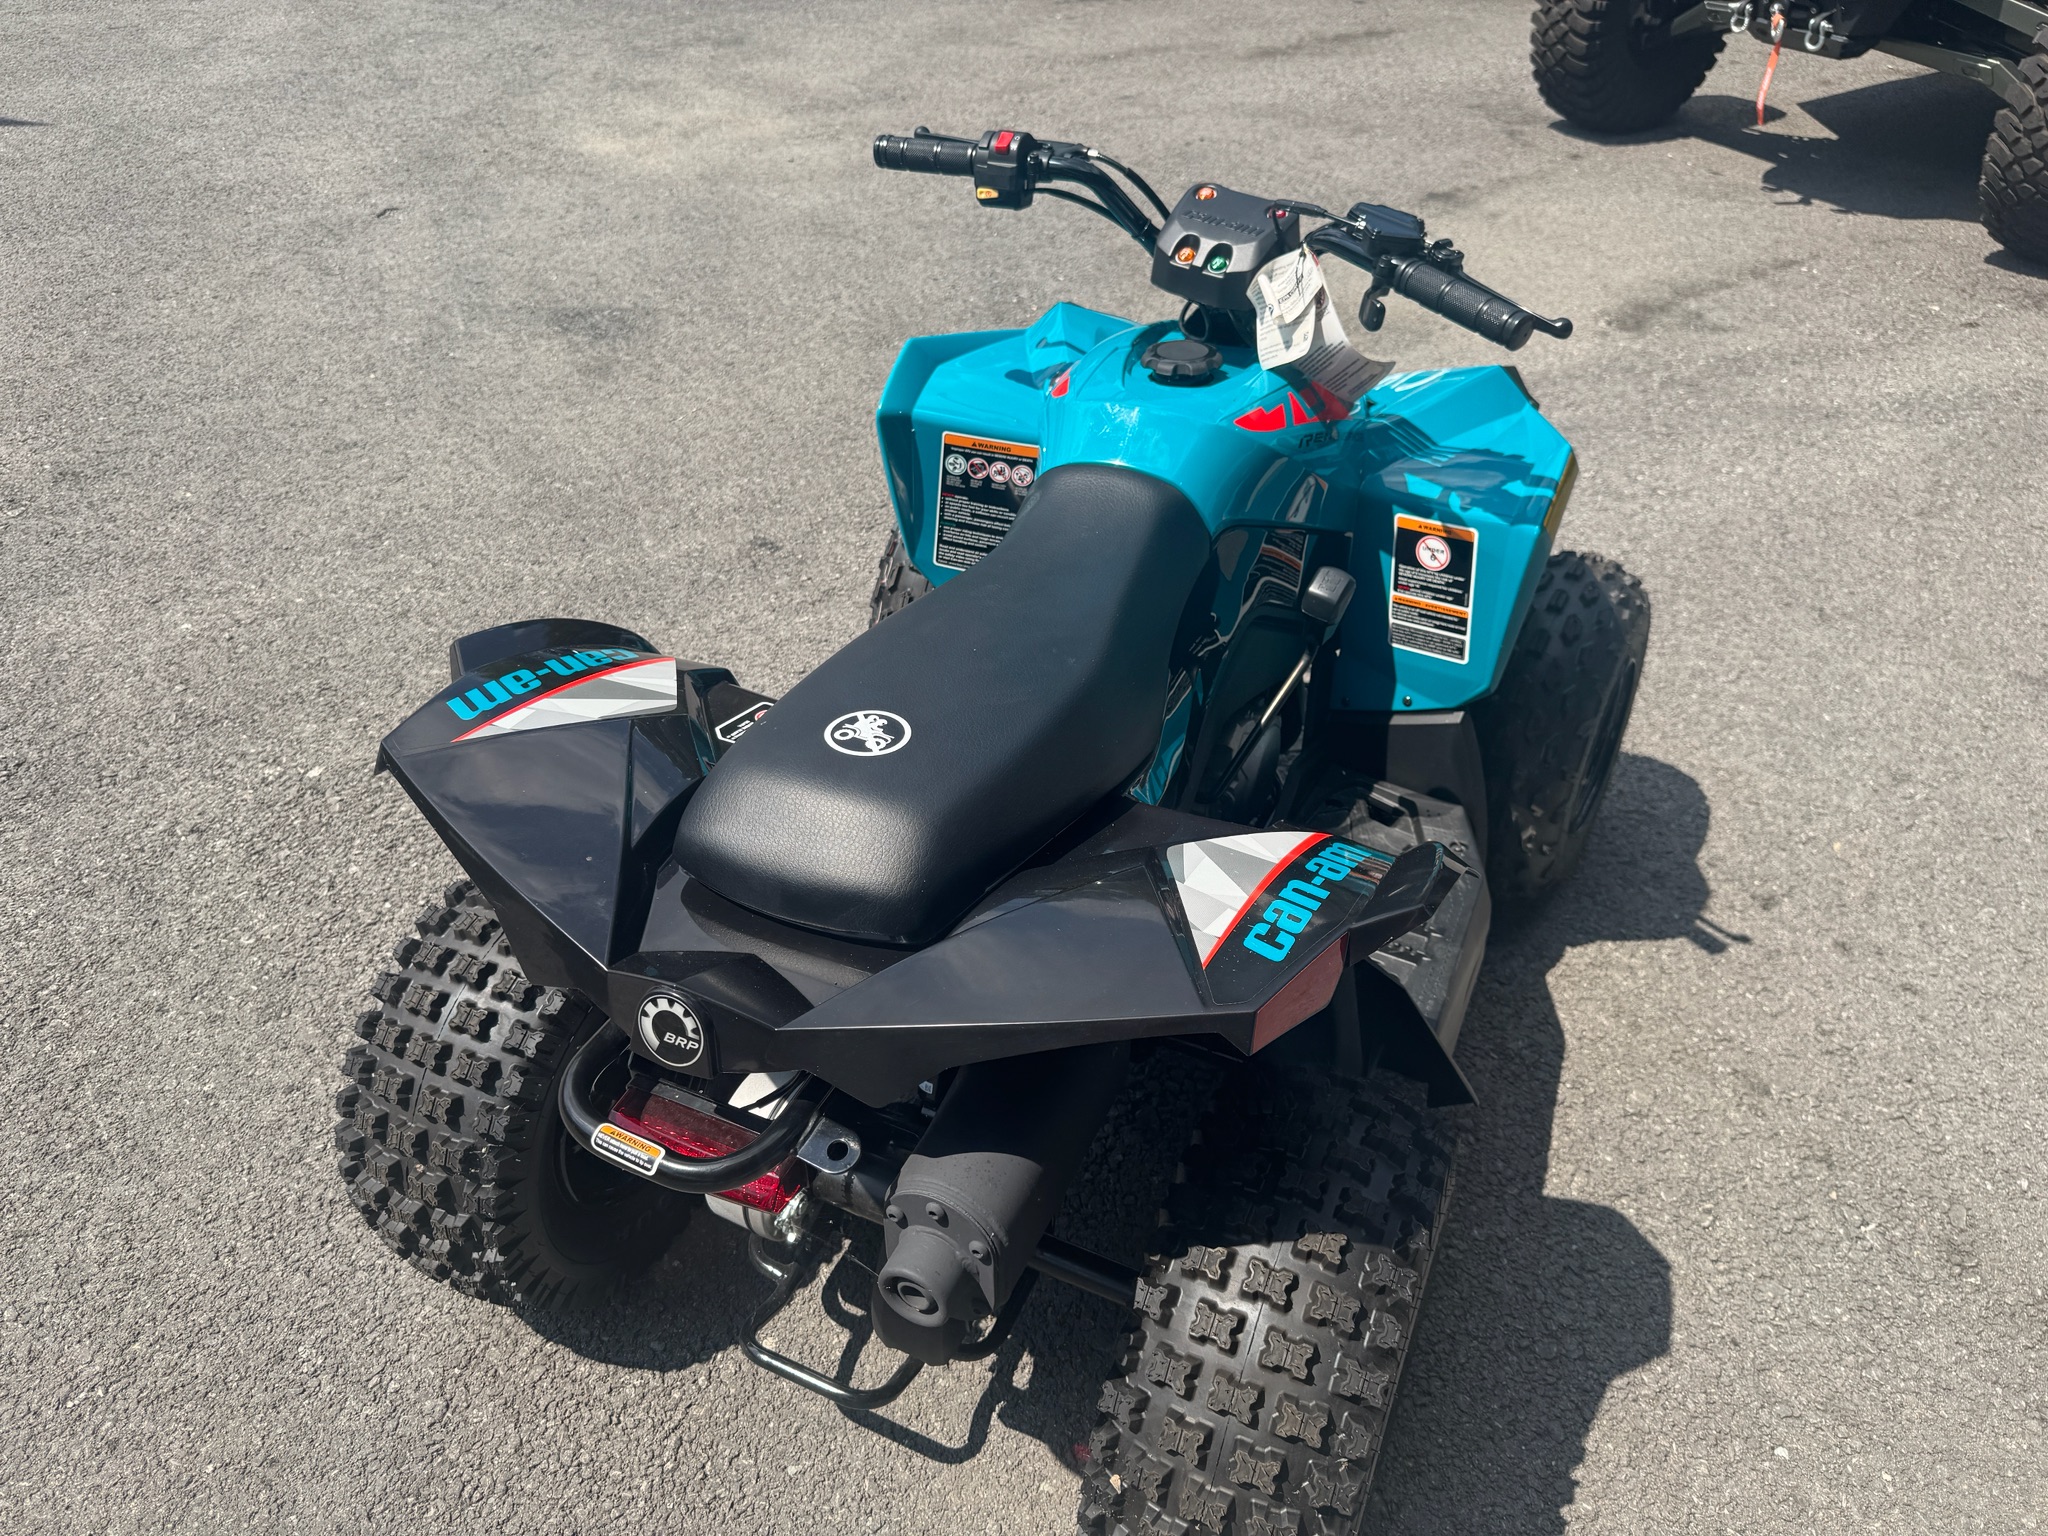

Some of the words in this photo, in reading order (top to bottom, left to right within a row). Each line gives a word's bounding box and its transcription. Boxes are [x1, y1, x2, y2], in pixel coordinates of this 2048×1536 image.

[978, 442, 1011, 452] WARNING
[446, 648, 639, 721] can-am
[1243, 842, 1371, 962] can-am
[663, 1032, 699, 1050] BRP
[615, 1131, 651, 1152] WARNING
